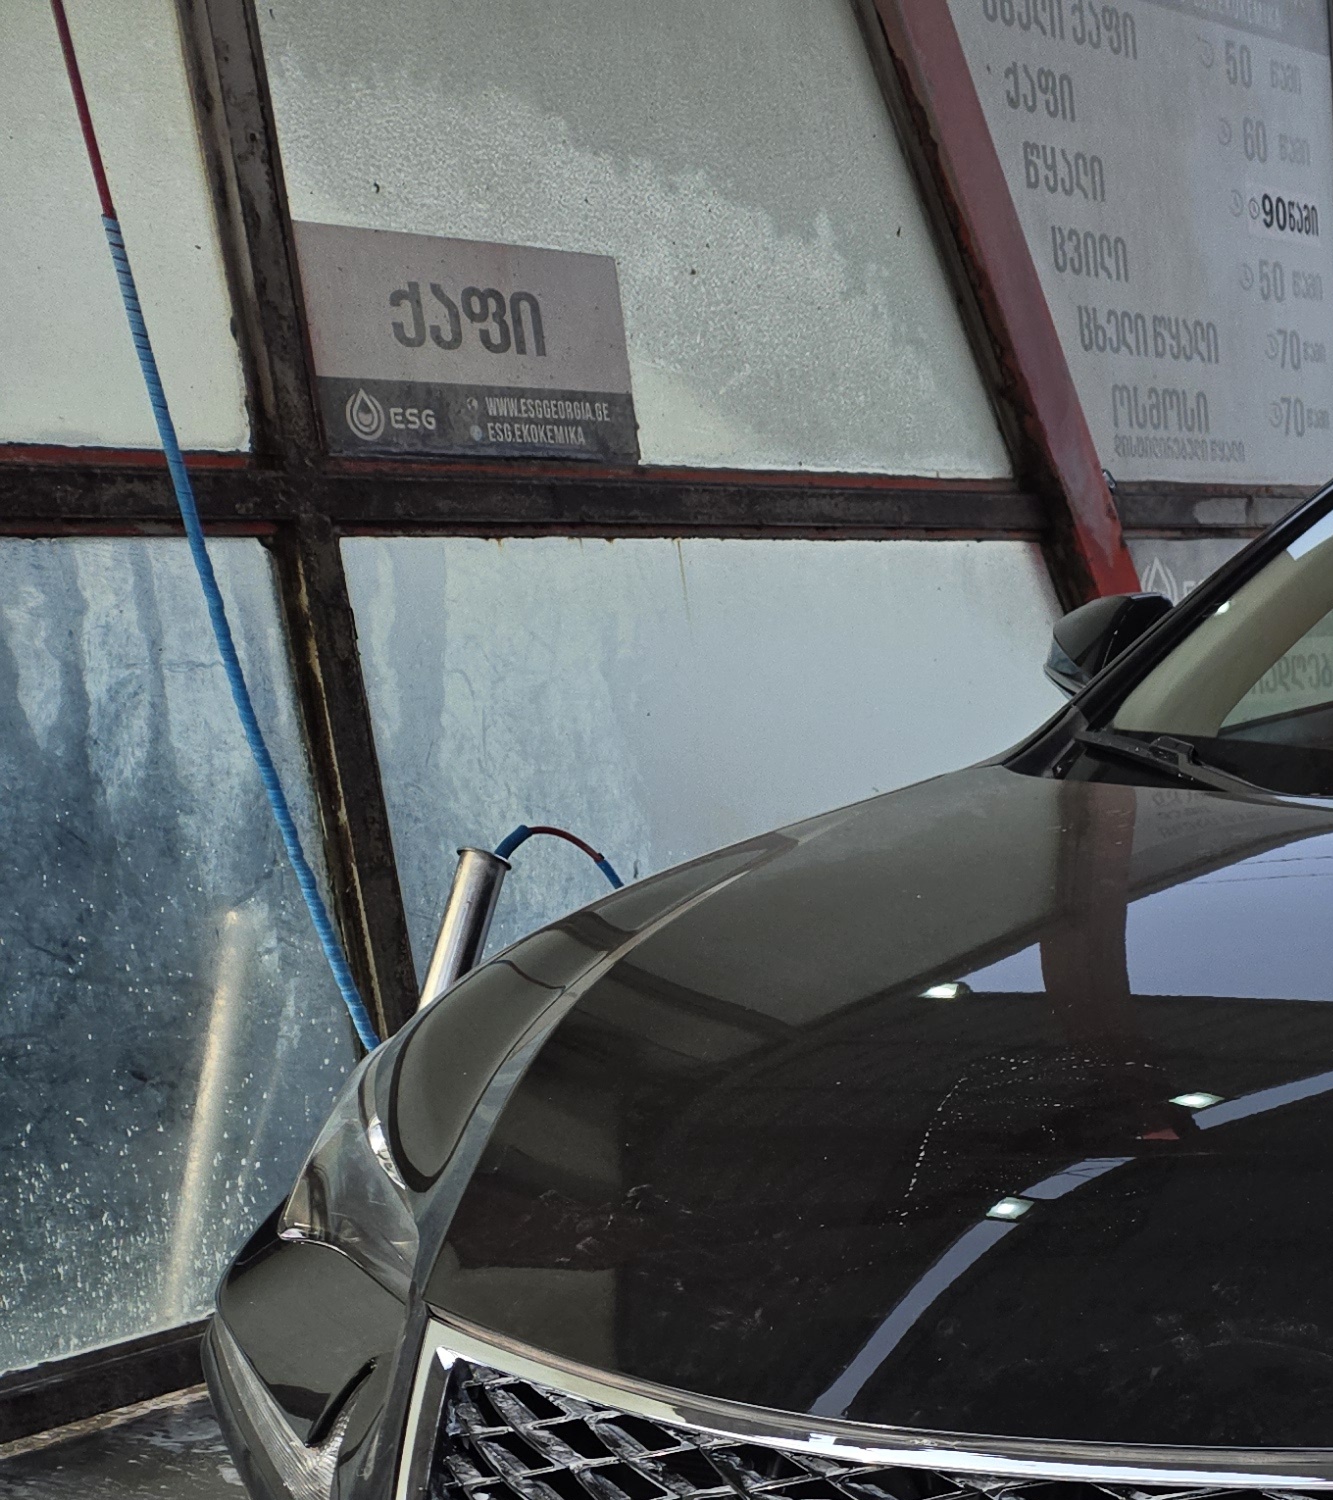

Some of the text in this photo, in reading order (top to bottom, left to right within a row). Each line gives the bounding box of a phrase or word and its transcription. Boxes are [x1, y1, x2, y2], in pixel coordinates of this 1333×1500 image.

[1224, 39, 1253, 89] 50
[1003, 61, 1076, 122] ქაფი
[1241, 116, 1269, 164] 60
[1022, 140, 1106, 202] წყალი
[1050, 225, 1129, 282] ცვილი
[1258, 258, 1286, 303] 50
[388, 281, 547, 357] ქაფი
[1077, 304, 1220, 365] ცხელი წყალი
[1276, 328, 1301, 371] 70
[388, 407, 437, 431] ESG
[484, 396, 611, 422] WWW.ESGGEORGIA.GE
[1111, 383, 1211, 434] ოსმოსი
[1280, 396, 1306, 438] 70
[486, 422, 586, 446] ESG.EKOKEMIKA
